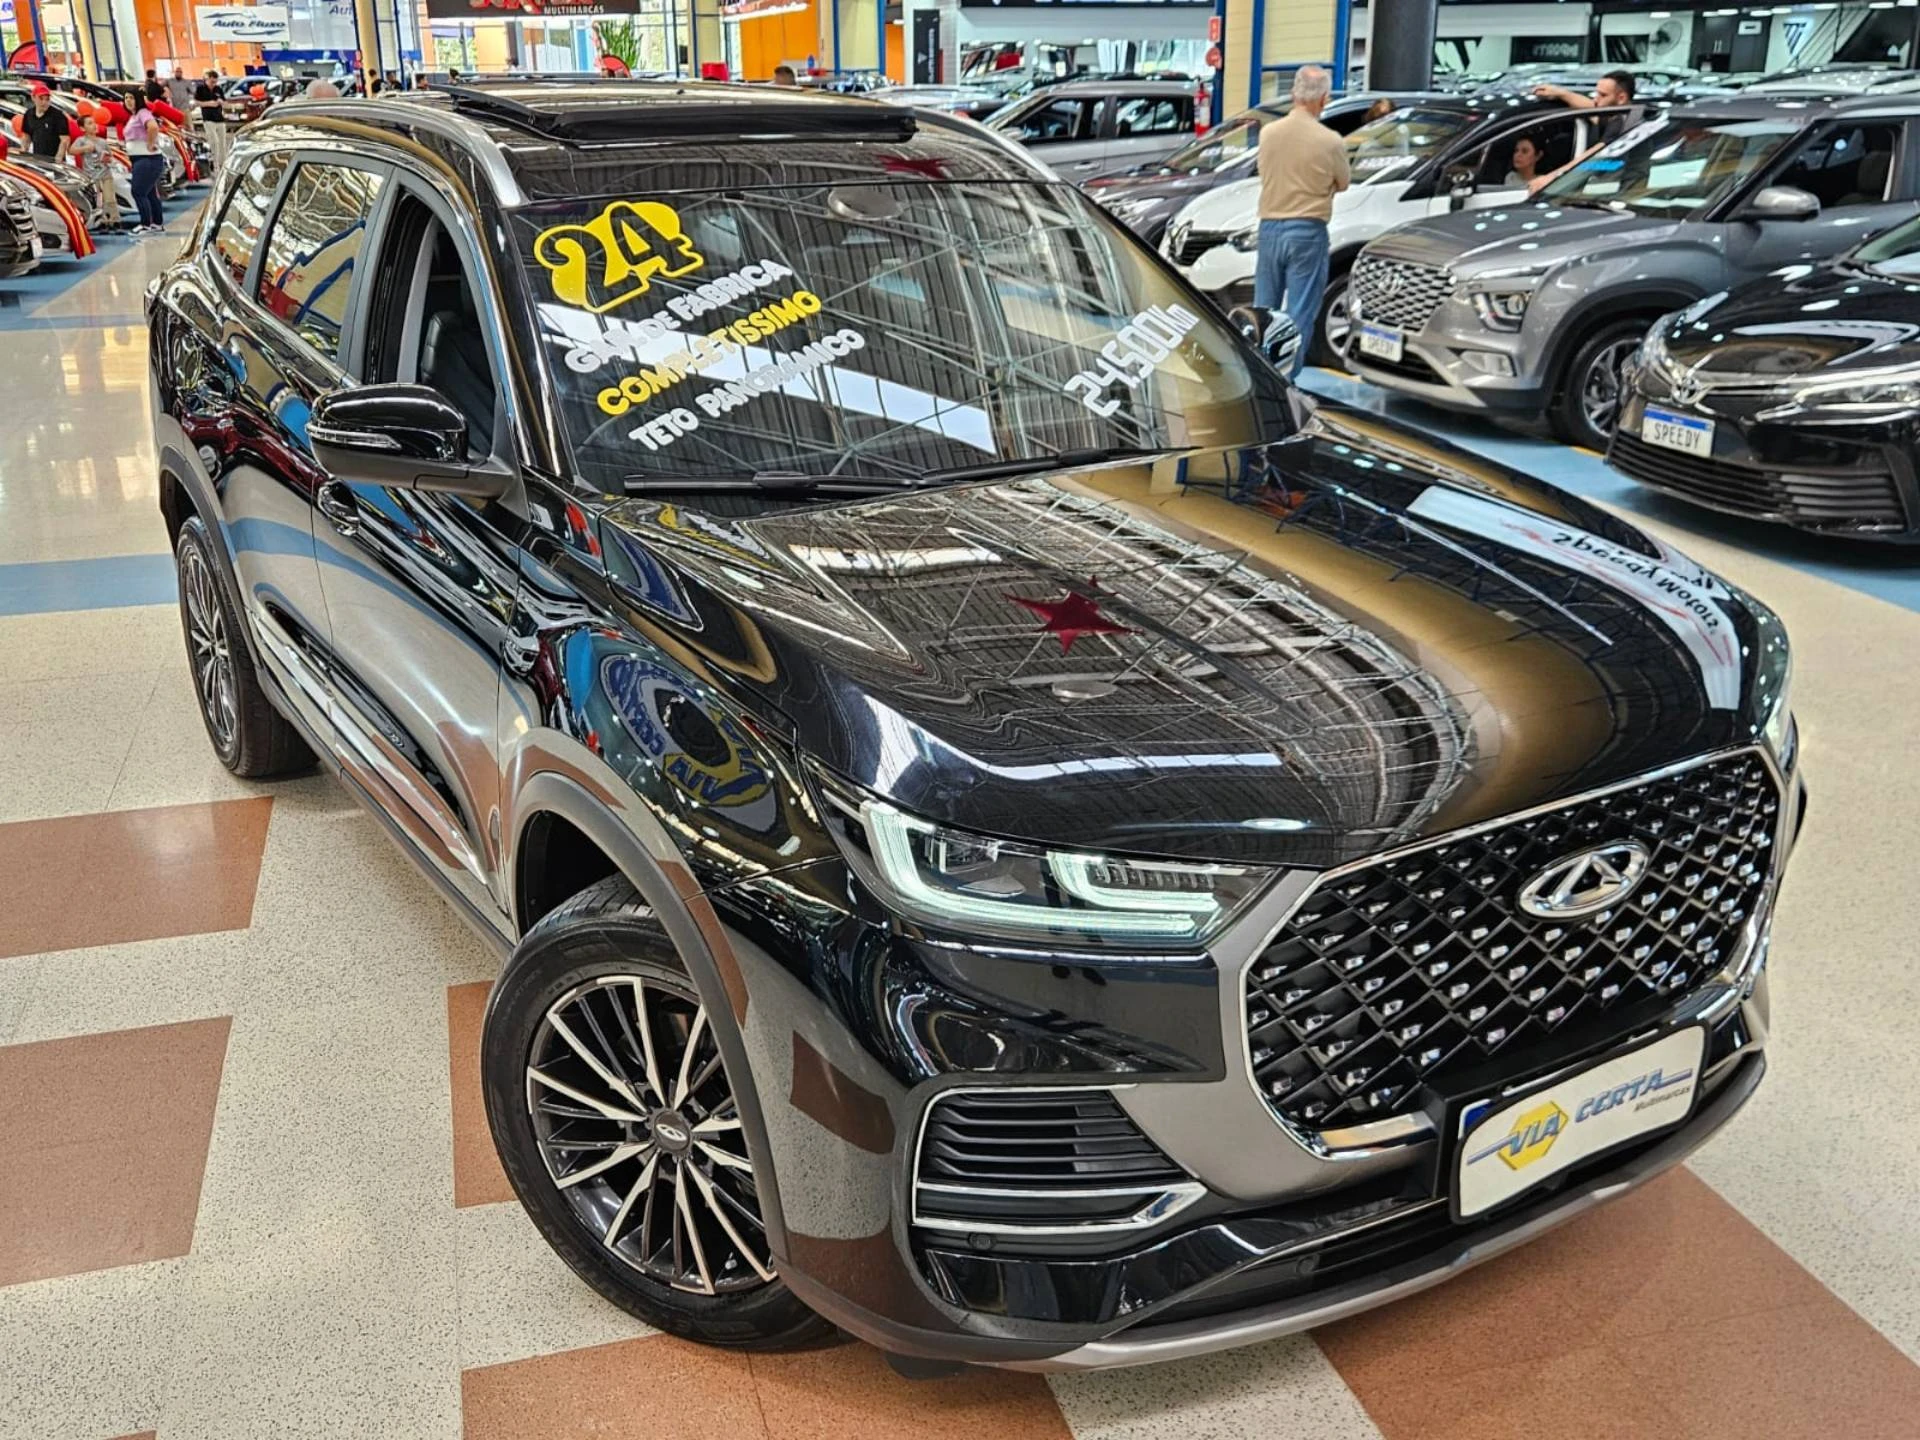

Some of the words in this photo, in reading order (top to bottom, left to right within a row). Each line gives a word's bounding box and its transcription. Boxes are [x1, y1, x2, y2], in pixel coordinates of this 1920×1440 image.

[212, 19, 245, 28] Auto
[248, 19, 287, 28] Fluxo
[544, 5, 604, 15] MULTIMARCAS
[534, 201, 704, 313] 24
[645, 310, 681, 340] DE
[628, 407, 700, 451] TETO
[1654, 422, 1700, 449] SPEEDY
[1509, 1111, 1560, 1156] VIA
[1575, 1068, 1664, 1123] CERTA
